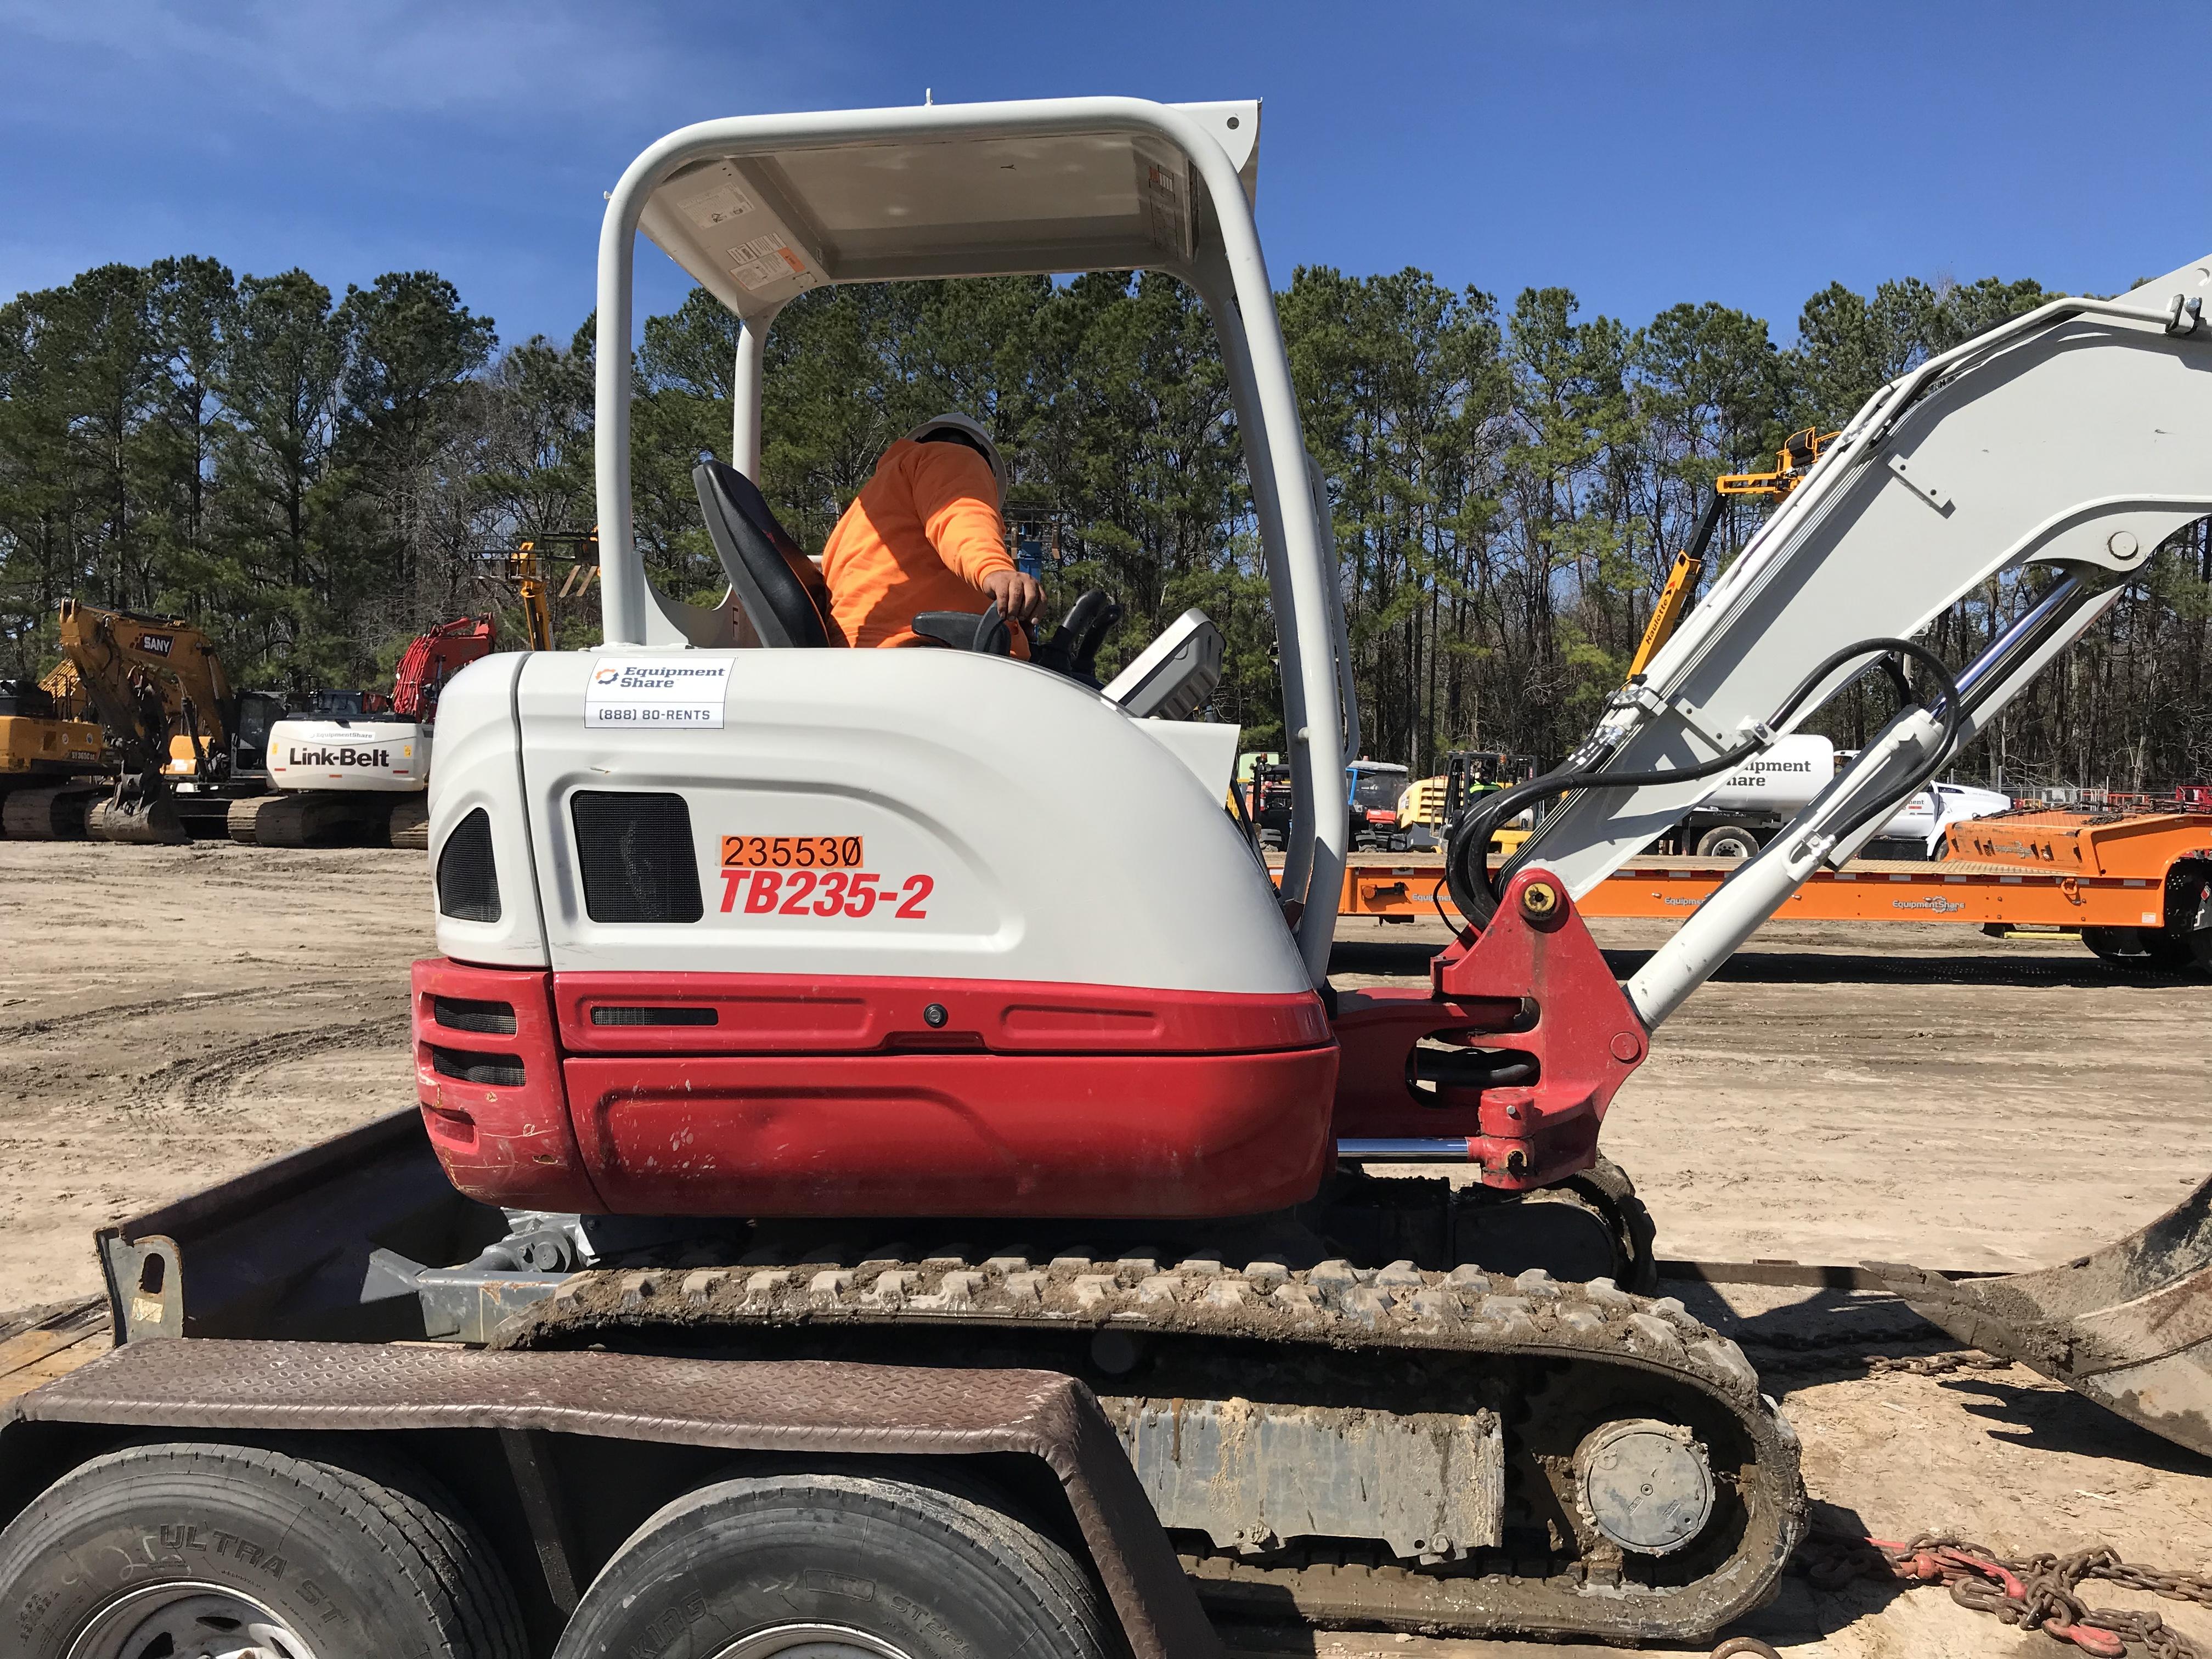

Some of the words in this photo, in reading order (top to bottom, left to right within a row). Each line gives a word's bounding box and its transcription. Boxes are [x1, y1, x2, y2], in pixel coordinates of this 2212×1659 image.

[1646, 599, 1668, 645] Haulotte
[144, 636, 170, 652] SANY
[624, 667, 725, 678] Equipment
[620, 678, 674, 688] Share
[599, 708, 636, 720] (888)
[642, 710, 710, 720] 80-RENTS
[290, 747, 389, 767] Link-Belt
[1744, 760, 1812, 774] ipment
[724, 836, 861, 867] 235530
[720, 870, 934, 919] TB235-2
[1892, 900, 1965, 909] EquipmentShare
[160, 1524, 287, 1581] ULTRA
[294, 1578, 349, 1624] ST
